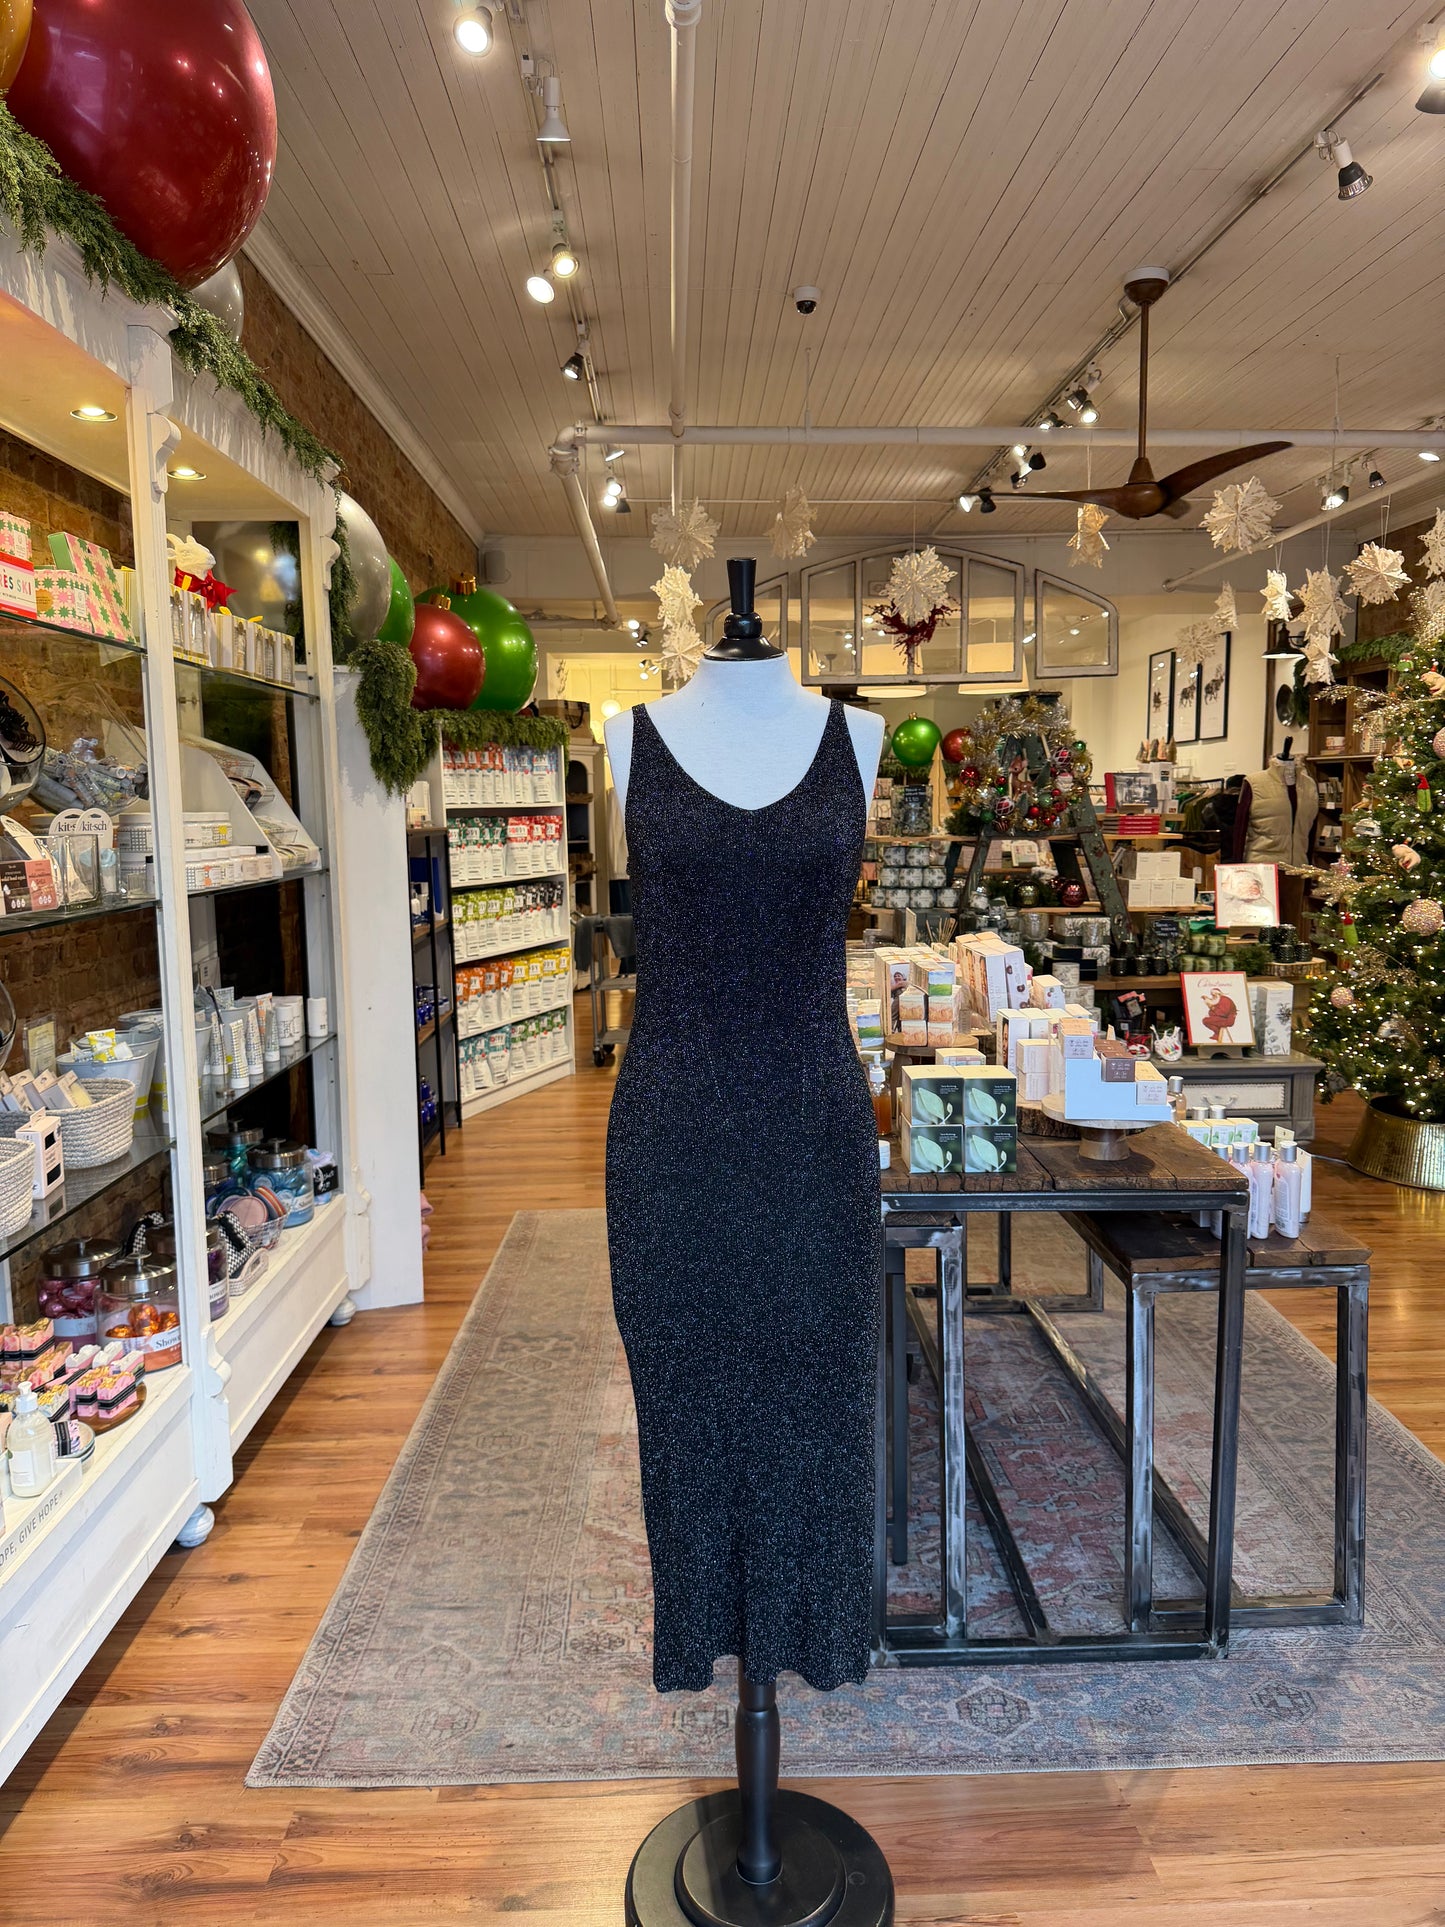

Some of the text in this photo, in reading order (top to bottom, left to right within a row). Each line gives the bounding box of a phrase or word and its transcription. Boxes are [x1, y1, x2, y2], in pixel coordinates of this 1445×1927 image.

[17, 579, 32, 596] SKI
[0, 1493, 58, 1567] OPE, GIVE HOPE
